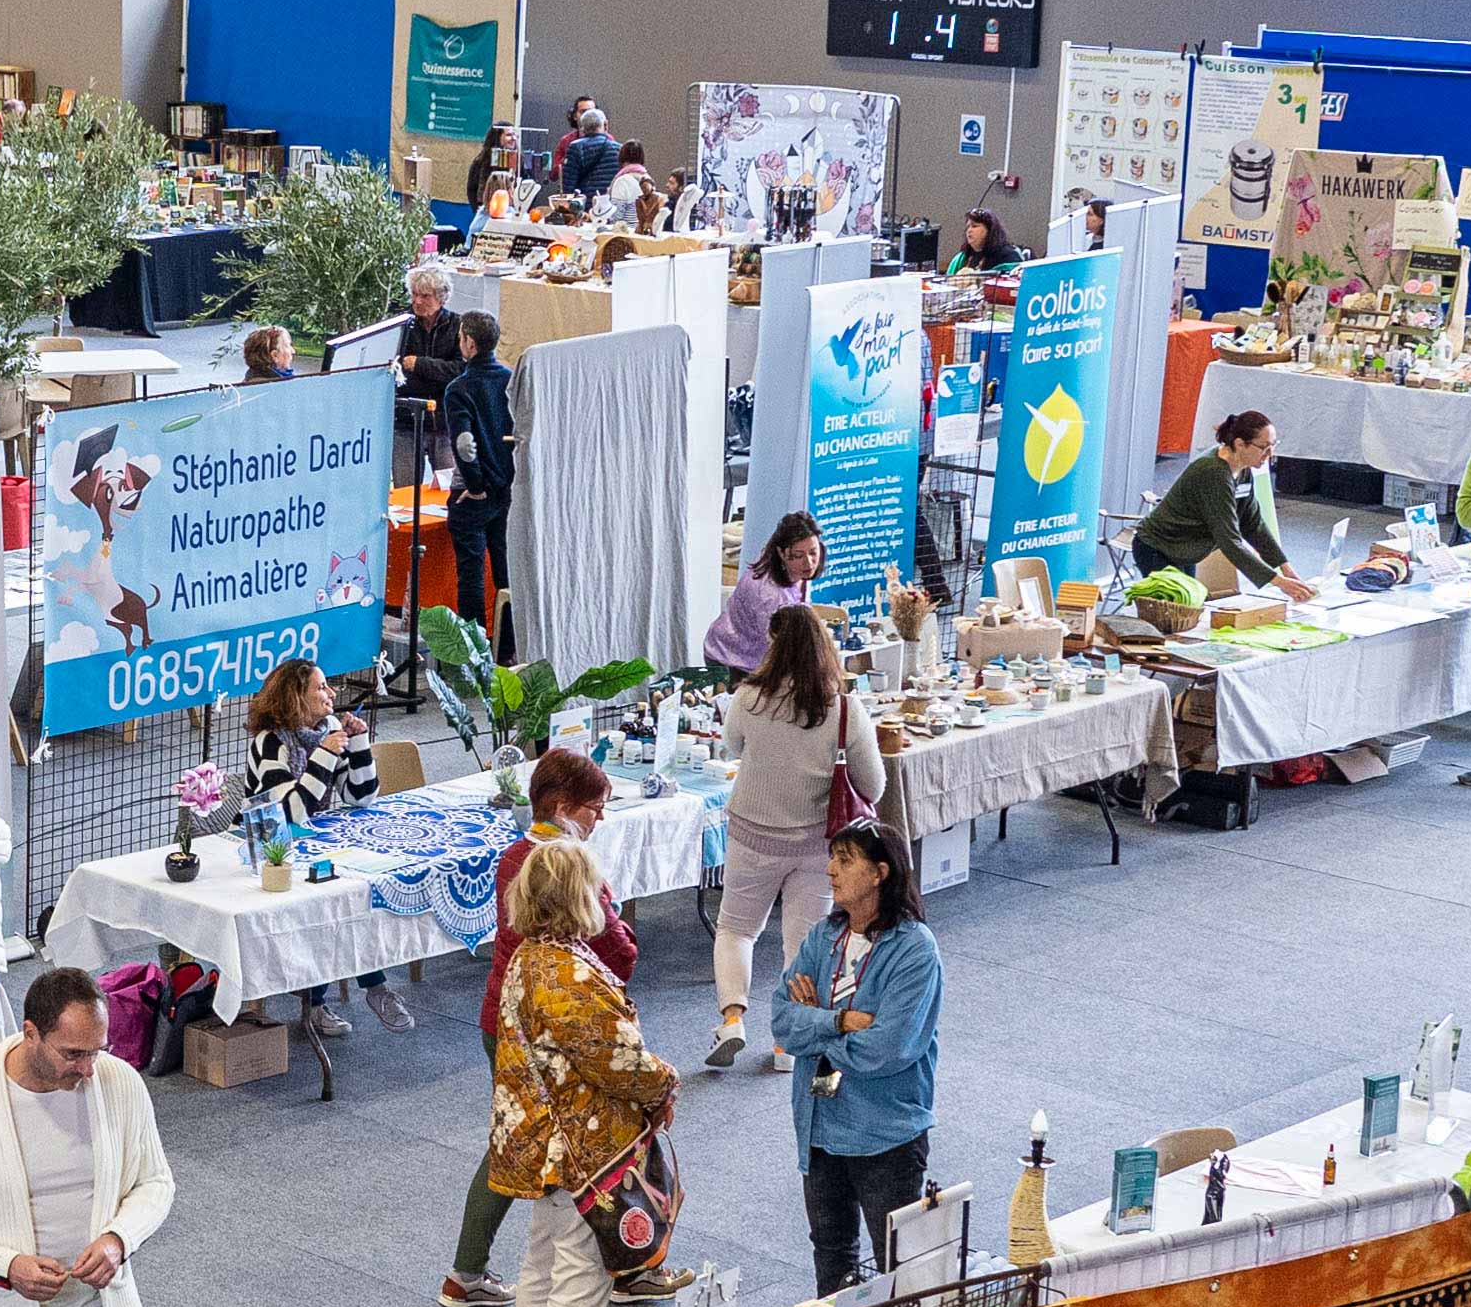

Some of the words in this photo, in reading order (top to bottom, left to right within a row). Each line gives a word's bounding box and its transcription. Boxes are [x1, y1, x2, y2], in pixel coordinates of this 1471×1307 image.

[889, 11, 899, 45] 1
[422, 62, 484, 78] Quintessence
[1120, 55, 1131, 64] de
[1133, 55, 1165, 65] Cuisson
[1205, 60, 1266, 74] Cuisson
[1278, 84, 1292, 104] 3
[1295, 104, 1306, 124] 1
[1322, 175, 1406, 200] HAKAWERK
[1027, 279, 1106, 321] colibris
[863, 336, 891, 356] ma
[1022, 343, 1051, 365] faire
[1055, 345, 1071, 359] sa
[1074, 335, 1102, 360] part
[864, 330, 916, 395] part
[824, 413, 848, 433] ÊTRE
[850, 409, 895, 428] ACTEUR
[815, 439, 829, 458] DU
[830, 428, 911, 455] CHANGEMENT
[172, 444, 297, 497] Stéphanie
[310, 428, 371, 472] Dardi
[171, 495, 326, 553] Naturopathe
[1014, 519, 1037, 535] ÊTRE
[1038, 513, 1077, 530] ACTEUR
[1002, 541, 1016, 554] DU
[1017, 528, 1087, 552] CHANGEMENT
[171, 559, 307, 612] Animalière
[109, 622, 320, 711] 0685741528
